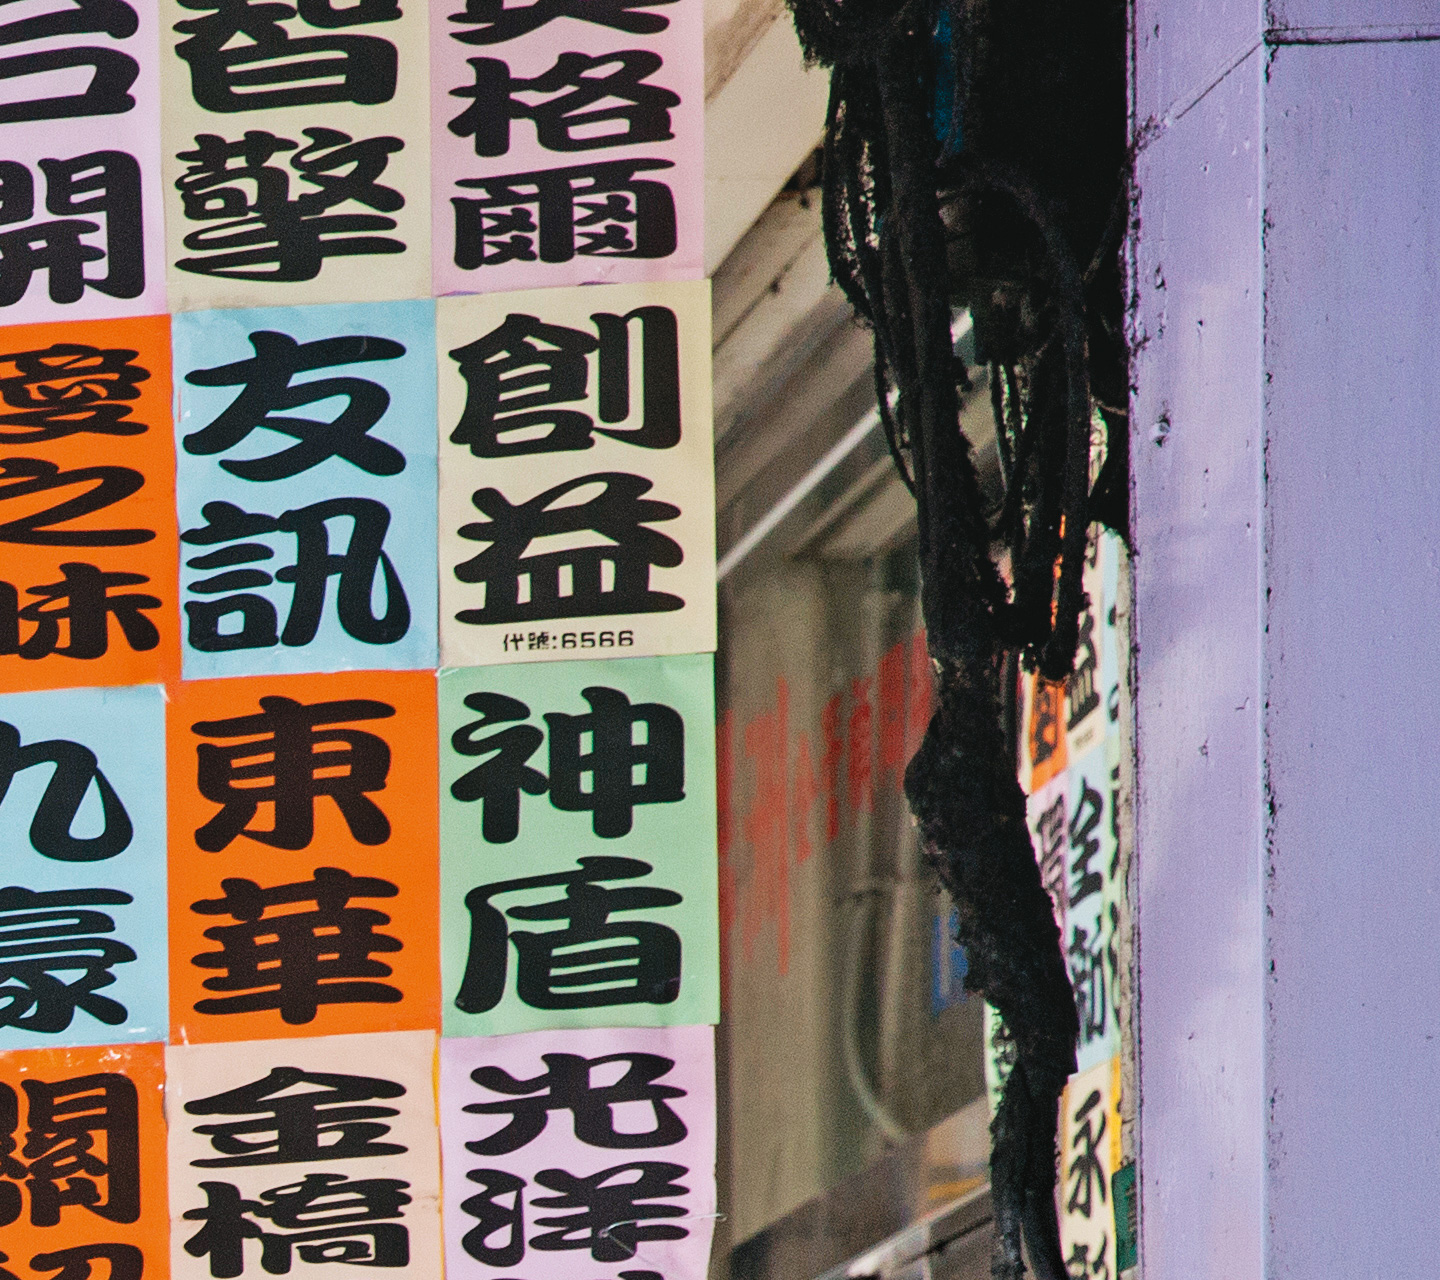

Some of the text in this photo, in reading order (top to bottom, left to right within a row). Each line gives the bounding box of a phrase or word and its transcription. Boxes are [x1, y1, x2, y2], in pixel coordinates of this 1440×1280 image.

[180, 331, 410, 652] 友訊
[449, 306, 684, 624] 創益
[191, 697, 402, 1024] 東華
[451, 687, 685, 1013] 神盾
